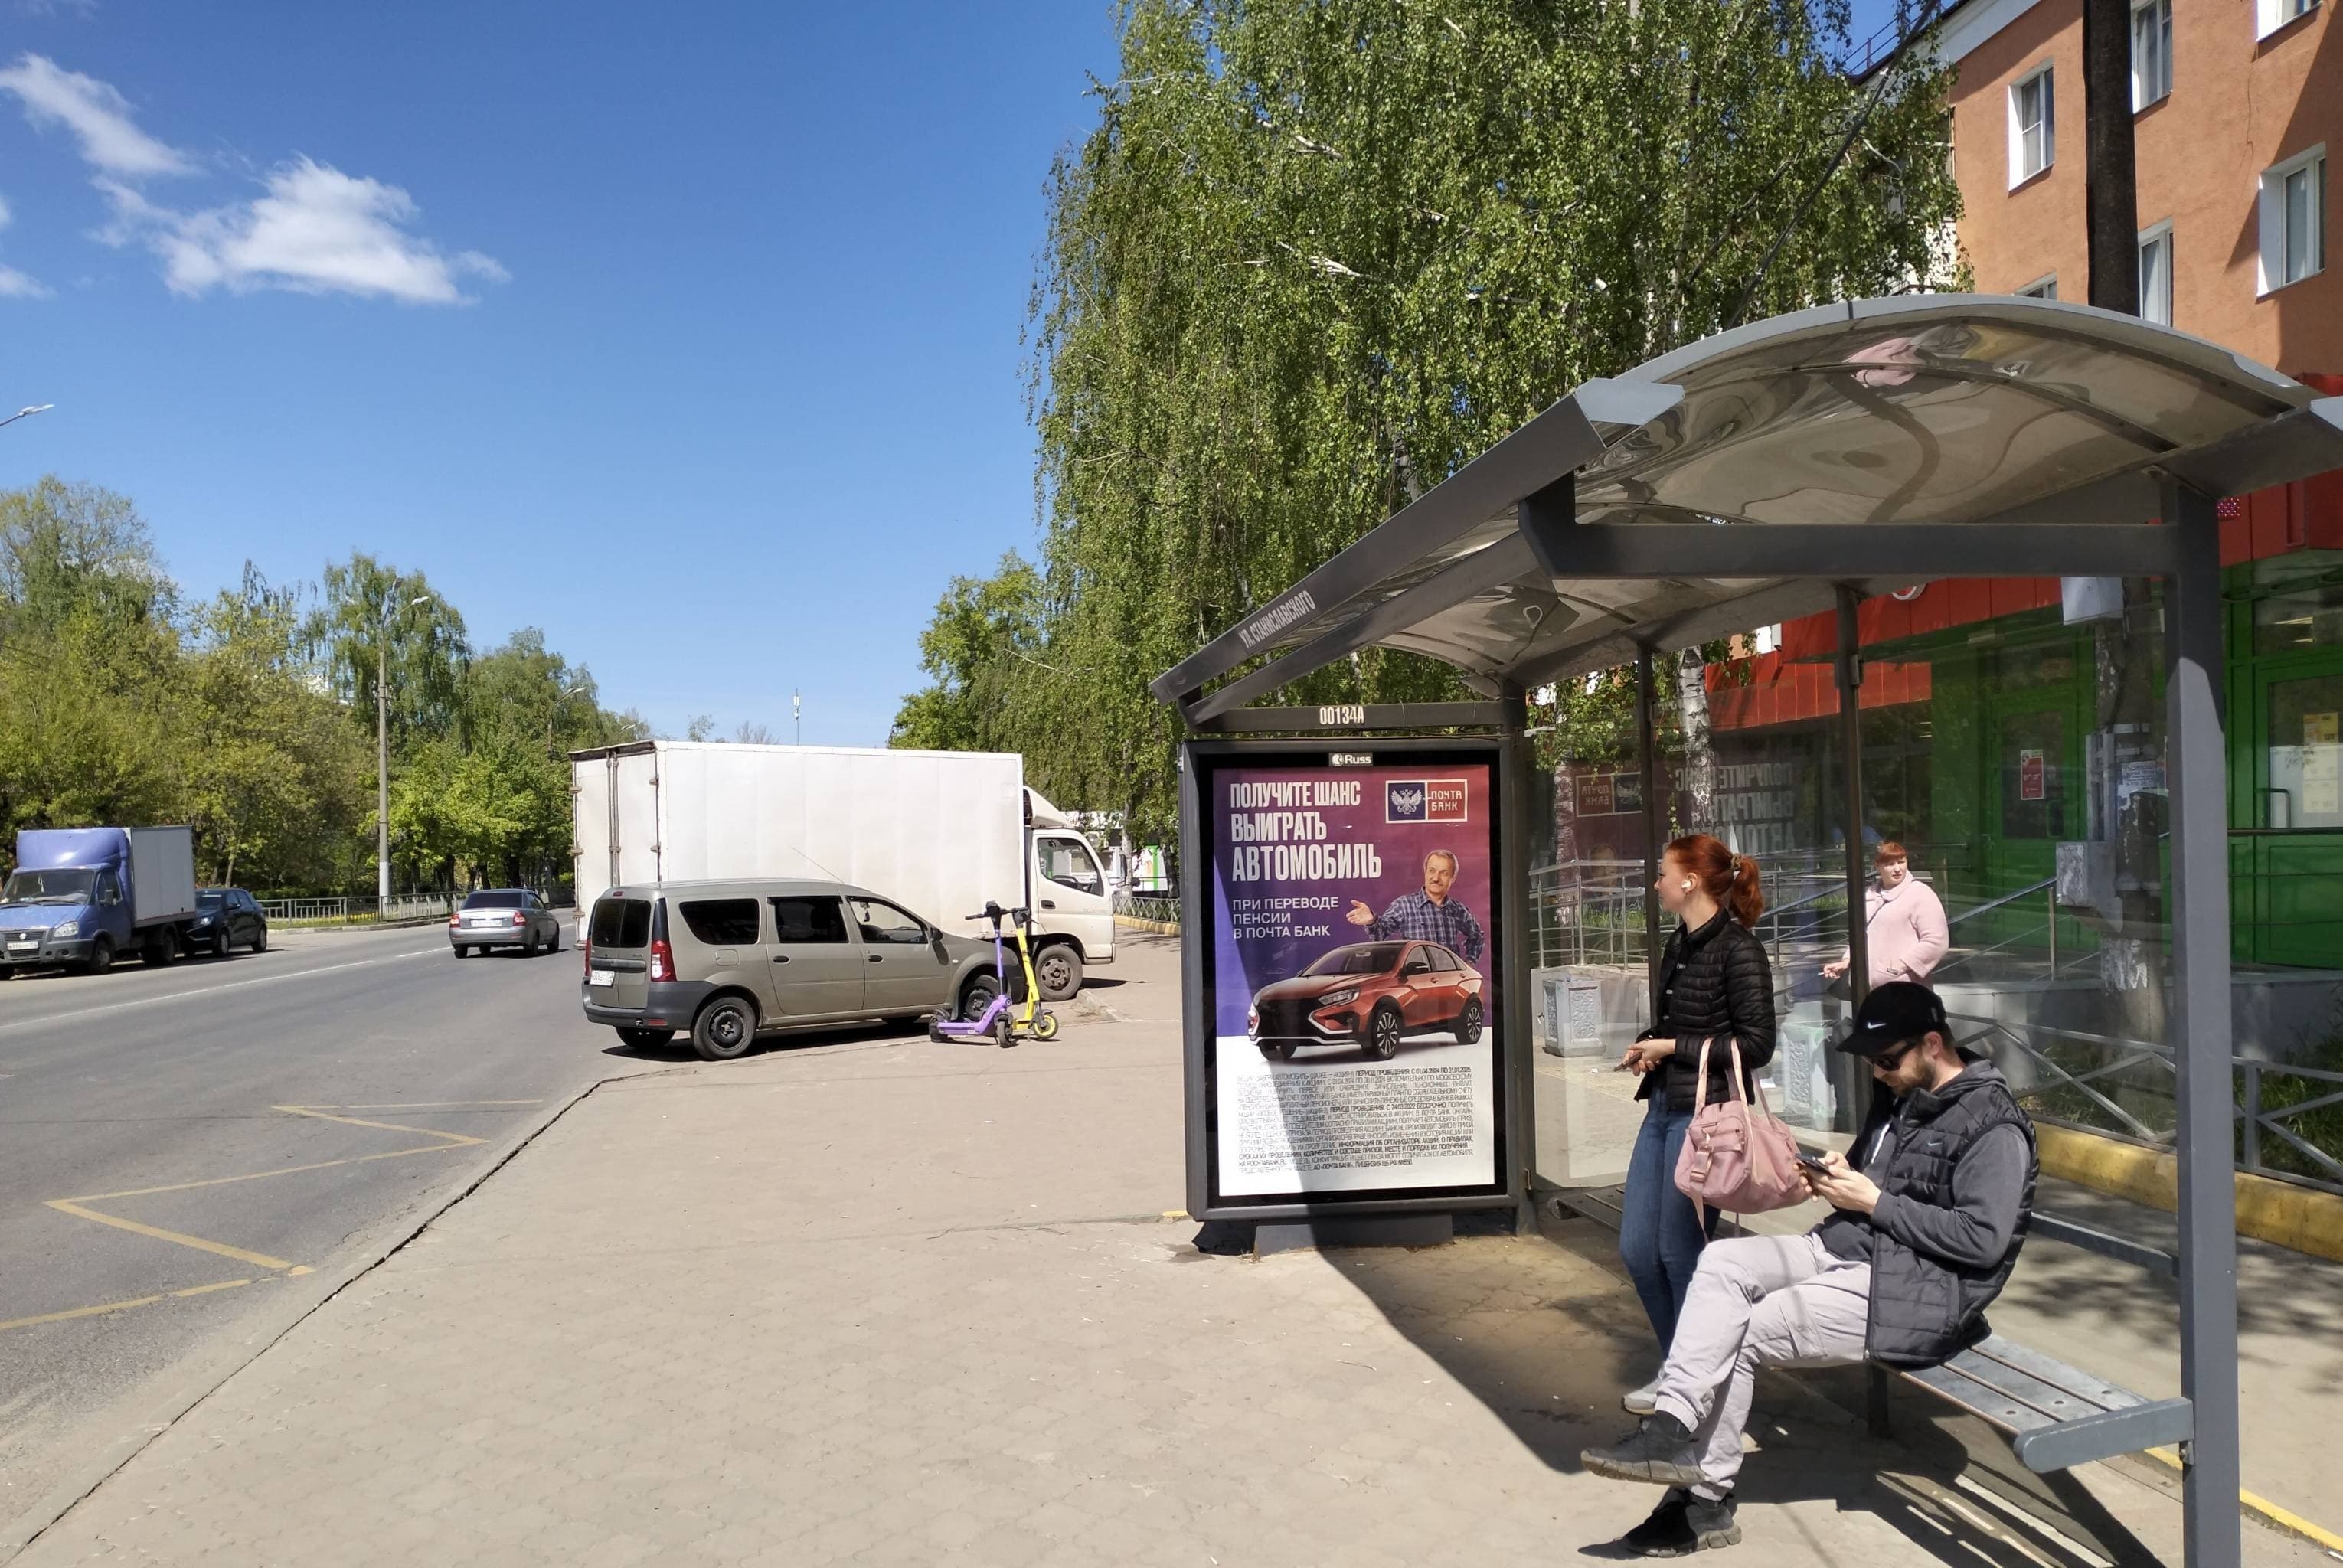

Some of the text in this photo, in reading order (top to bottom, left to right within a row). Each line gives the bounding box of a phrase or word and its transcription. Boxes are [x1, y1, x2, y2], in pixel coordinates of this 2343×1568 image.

[1238, 590, 1316, 649] УЛ. СТАНИСЛАВСКОГО
[1344, 754, 1371, 764] Russ
[1230, 781, 1361, 808] ПОЛУЧИТЕ ШАНС
[1431, 790, 1462, 801] ПОЧТА
[1431, 801, 1459, 812] БАНК
[1231, 812, 1327, 842] ВЫИГРАТЬ
[1232, 843, 1382, 882] АВТОМОБИЛЬ
[1233, 896, 1339, 910] ПРИ ПЕРЕВОДЕ
[1233, 912, 1292, 925] ПЕНСИИ
[1234, 925, 1331, 939] В ПОЧТА БАНК
